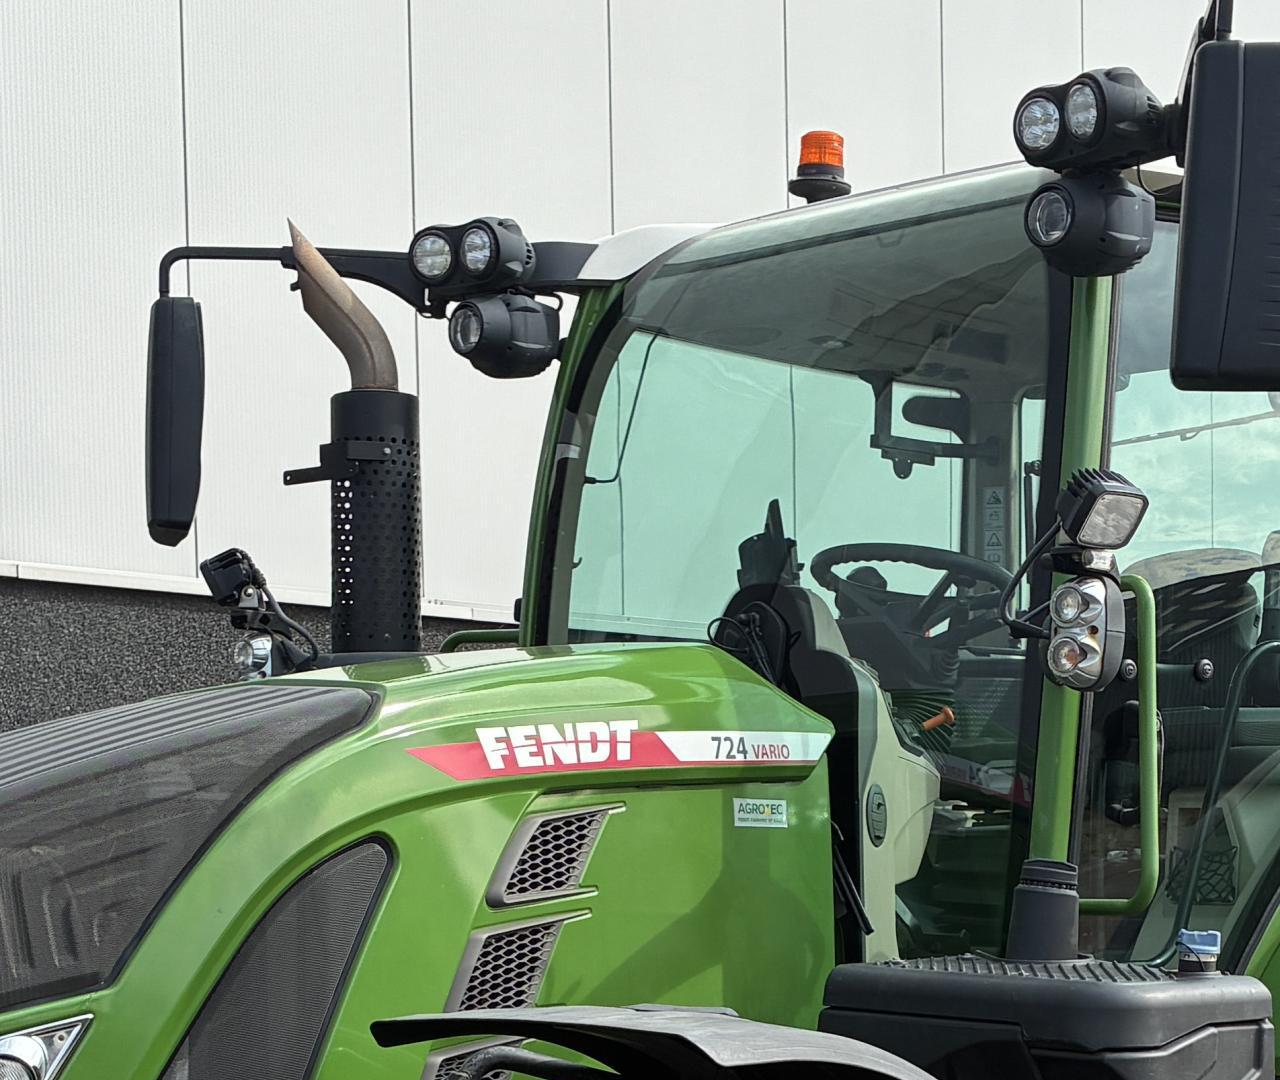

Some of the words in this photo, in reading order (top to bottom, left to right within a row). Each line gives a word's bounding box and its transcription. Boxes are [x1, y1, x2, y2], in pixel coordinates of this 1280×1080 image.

[476, 719, 639, 770] FENDT
[711, 736, 749, 760] 724
[751, 743, 791, 760] VARIO
